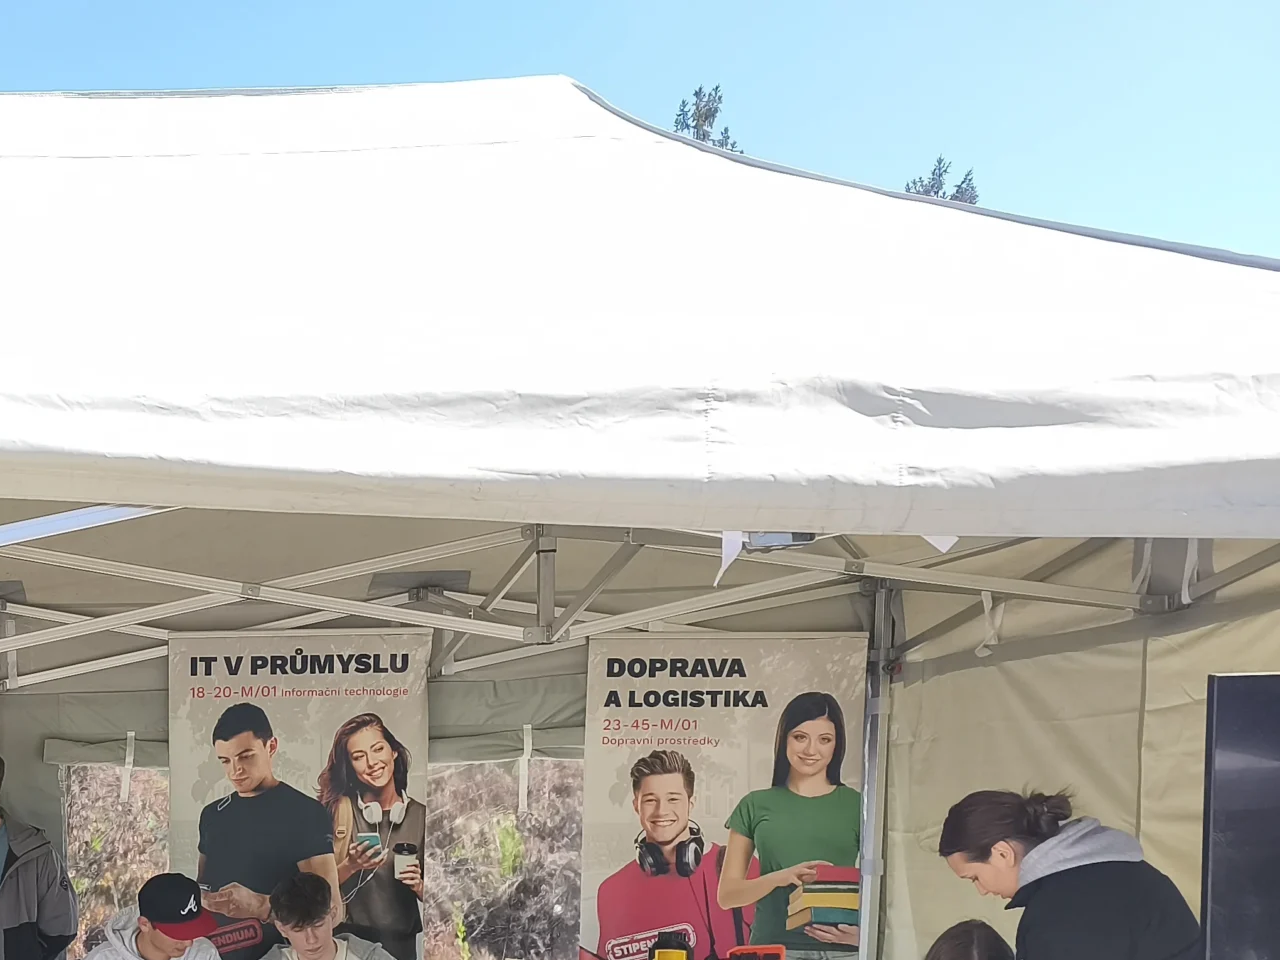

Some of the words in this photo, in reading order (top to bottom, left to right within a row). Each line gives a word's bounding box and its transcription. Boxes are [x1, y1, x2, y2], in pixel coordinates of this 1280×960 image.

[190, 656, 217, 676] IT
[224, 656, 243, 676] V
[250, 648, 409, 675] PRŮMYSLU
[606, 657, 747, 678] DOPRAVA
[189, 685, 278, 699] 18-20-M/01
[281, 687, 340, 697] Informační
[344, 686, 409, 698] technologie
[604, 690, 621, 708] A
[628, 690, 768, 708] LOGISTIKA
[602, 718, 698, 731] 23-45-M/01
[602, 736, 653, 746] Dopravní
[657, 736, 720, 747] prostředky
[211, 927, 256, 946] ENDIUM
